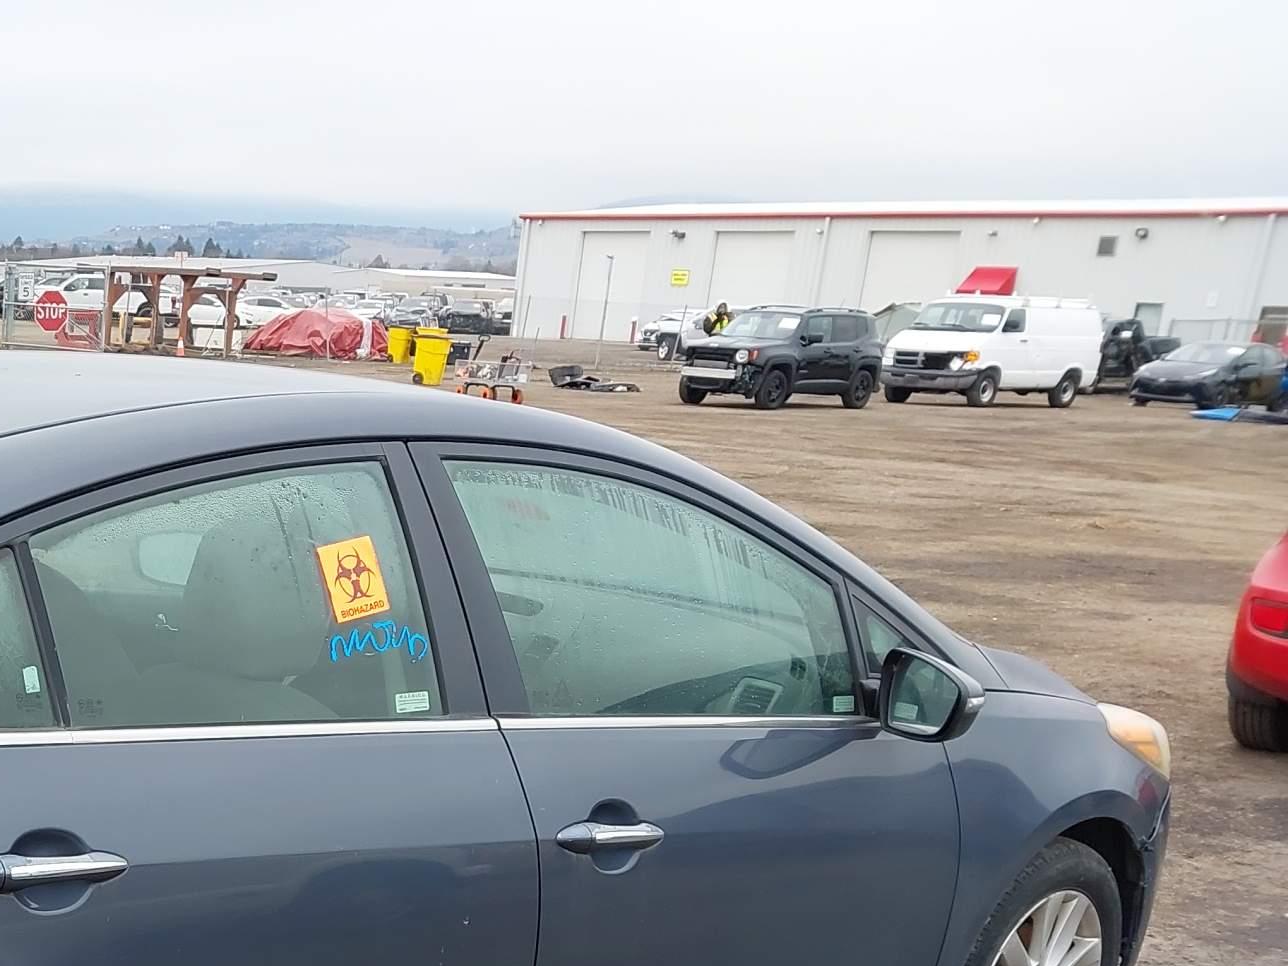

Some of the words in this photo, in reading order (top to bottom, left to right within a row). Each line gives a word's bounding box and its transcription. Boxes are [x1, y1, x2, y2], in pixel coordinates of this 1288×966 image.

[22, 286, 30, 298] 5
[37, 302, 66, 319] STOP
[340, 599, 386, 619] BIOHAZARD
